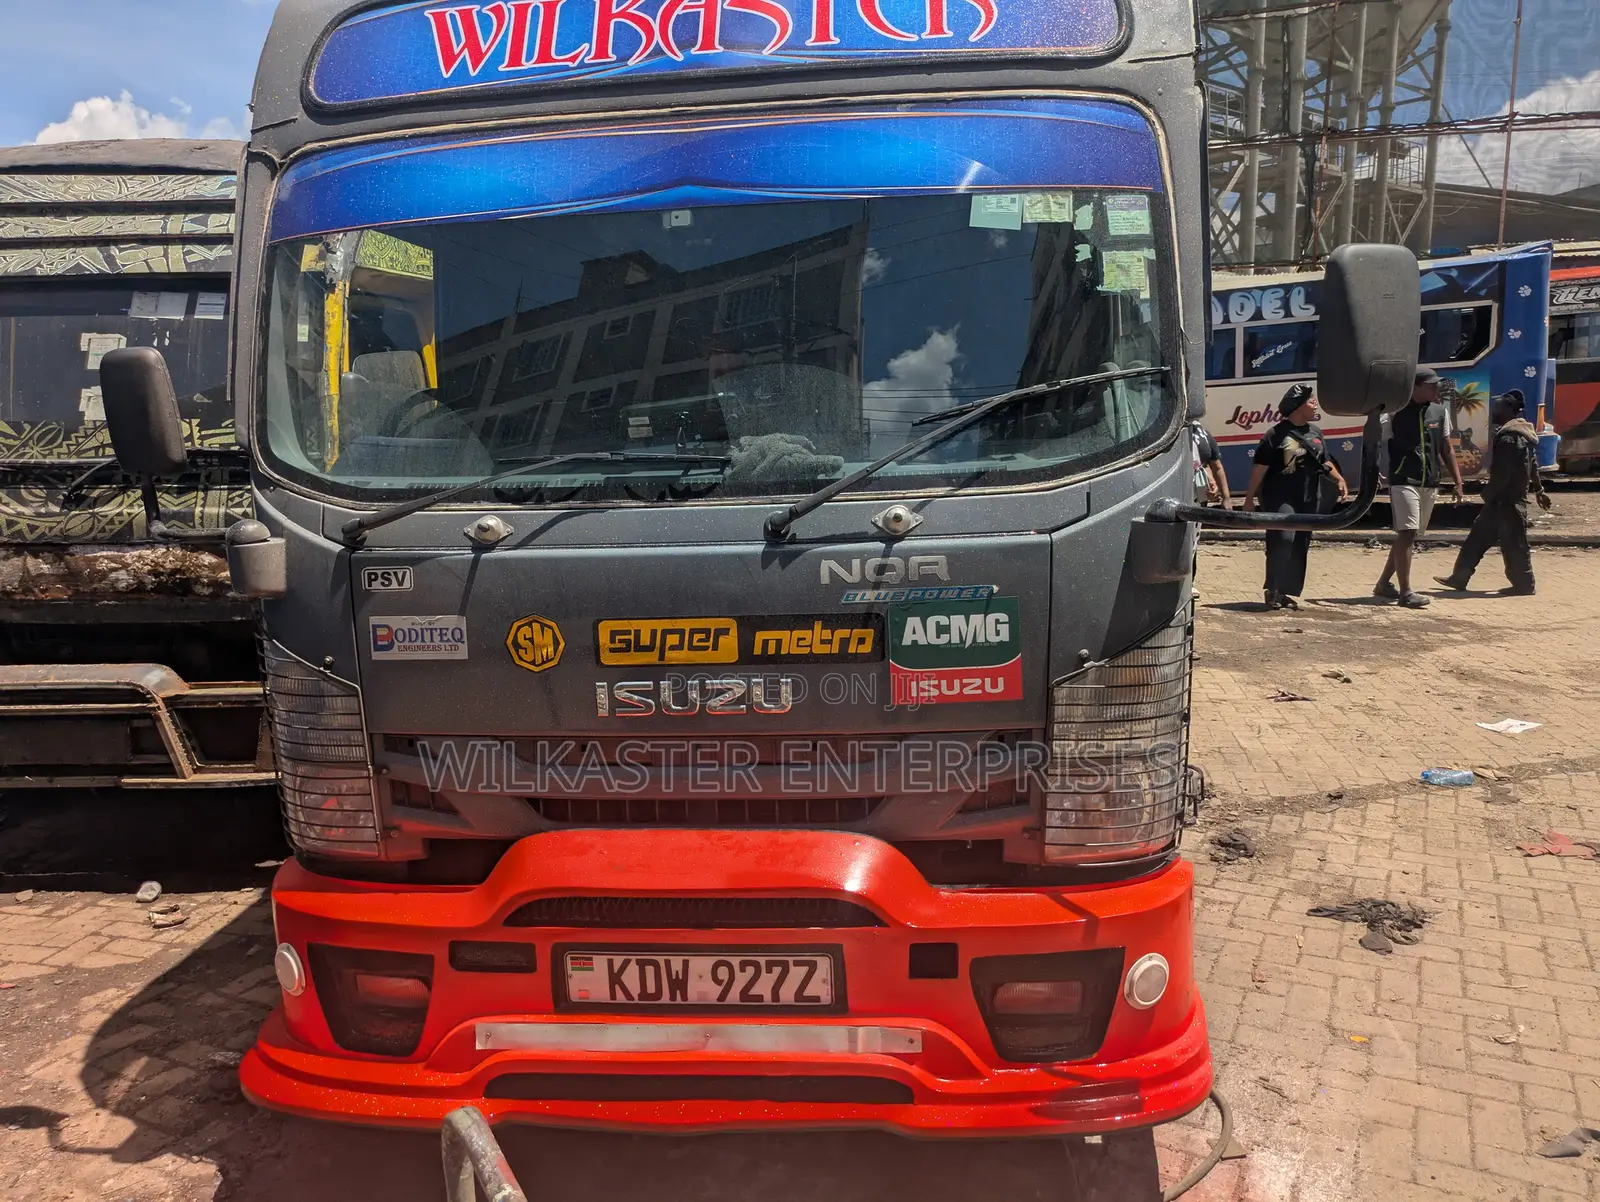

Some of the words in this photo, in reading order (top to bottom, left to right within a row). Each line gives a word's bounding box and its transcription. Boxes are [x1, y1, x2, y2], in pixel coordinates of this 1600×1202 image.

[366, 569, 409, 588] PSV
[820, 555, 951, 585] NQR
[371, 624, 466, 652] BODITEQ
[517, 622, 553, 664] SM
[609, 627, 731, 661] super
[753, 621, 875, 656] metro
[901, 612, 1010, 649] ACMG
[397, 644, 442, 652] ENGINEERS
[443, 644, 460, 652] LTD
[595, 678, 793, 717] ISUZU
[911, 677, 1005, 697] ISUZU
[606, 958, 690, 1002] KDW
[710, 959, 822, 1003] 927Z
